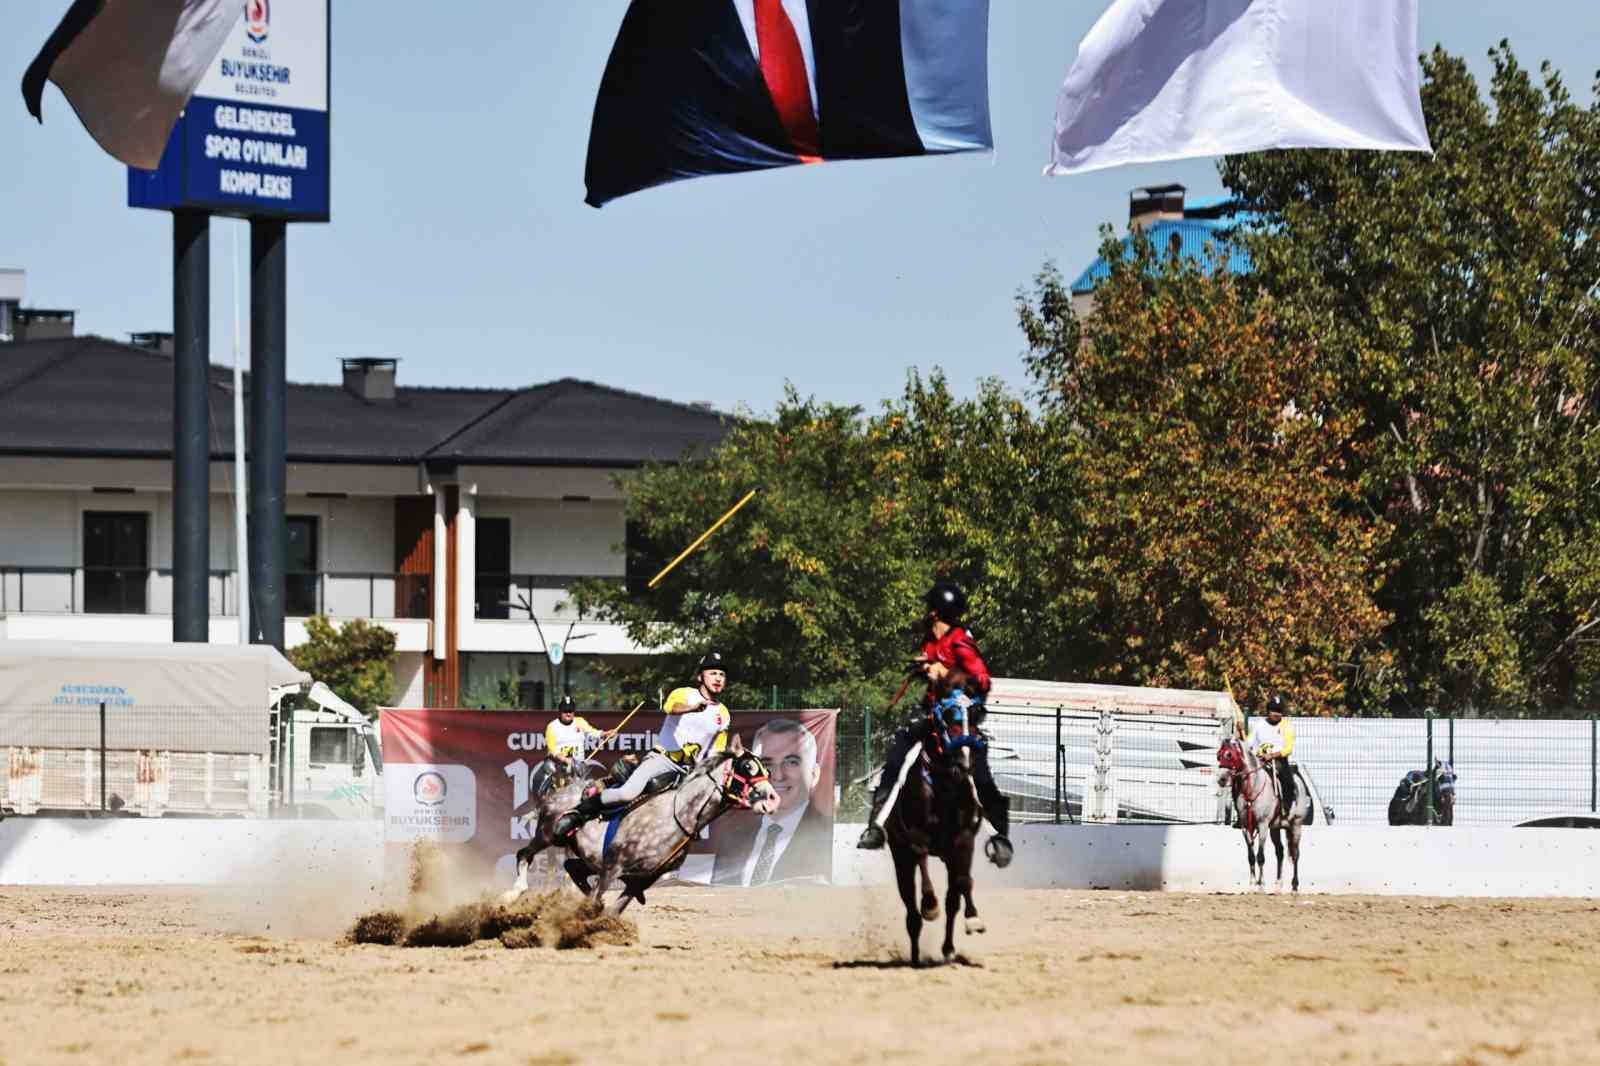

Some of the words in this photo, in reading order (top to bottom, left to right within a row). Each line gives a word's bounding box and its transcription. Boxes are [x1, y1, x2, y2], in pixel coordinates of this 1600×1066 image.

[214, 105, 296, 136] GELENEKSEL
[205, 134, 241, 161] SPOR
[242, 138, 308, 169] OYUNLARI
